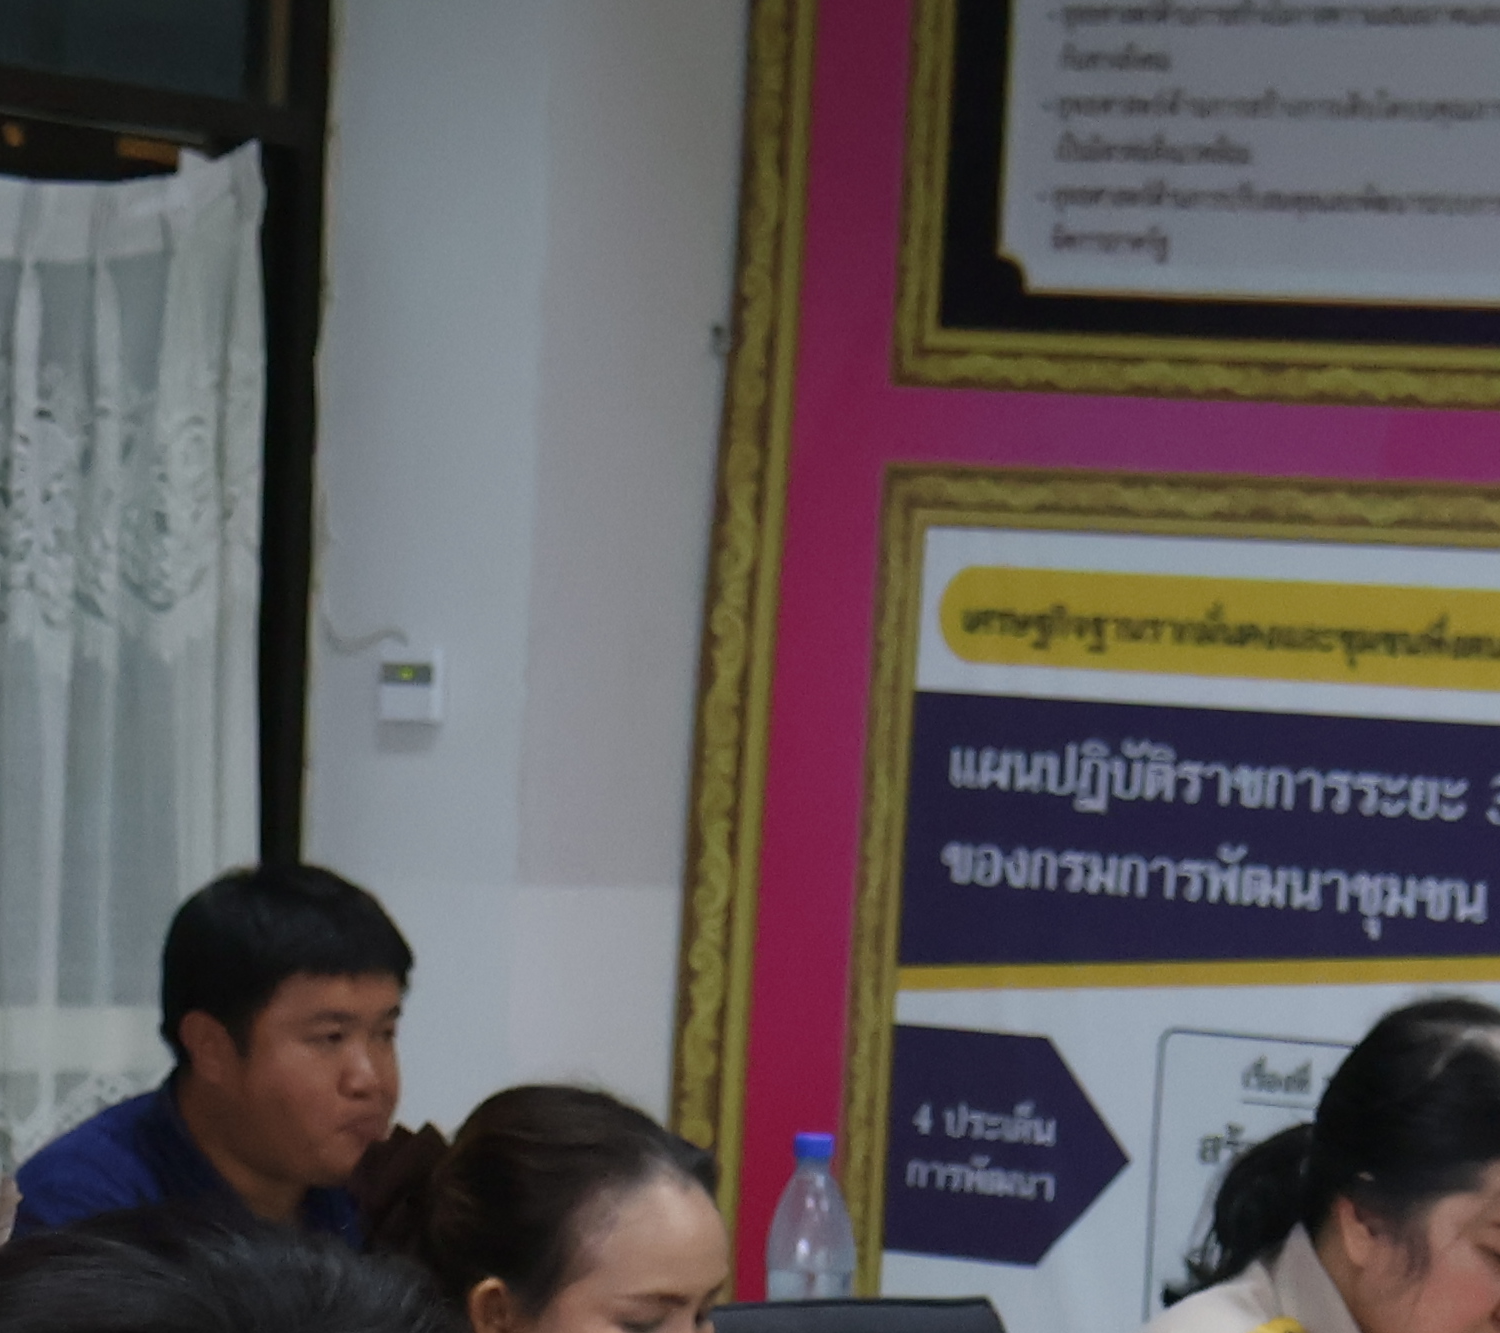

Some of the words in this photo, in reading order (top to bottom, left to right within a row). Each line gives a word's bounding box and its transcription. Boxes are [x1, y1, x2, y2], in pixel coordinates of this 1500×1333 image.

[948, 737, 1469, 822] แผนปฏิบัติราชการระยะ
[940, 841, 1490, 941] ของกรมการพัฒนาชุมชน
[911, 1102, 933, 1136] 4
[943, 1102, 1057, 1148] ประเด็น
[905, 1154, 1057, 1203] การพัฒนา
